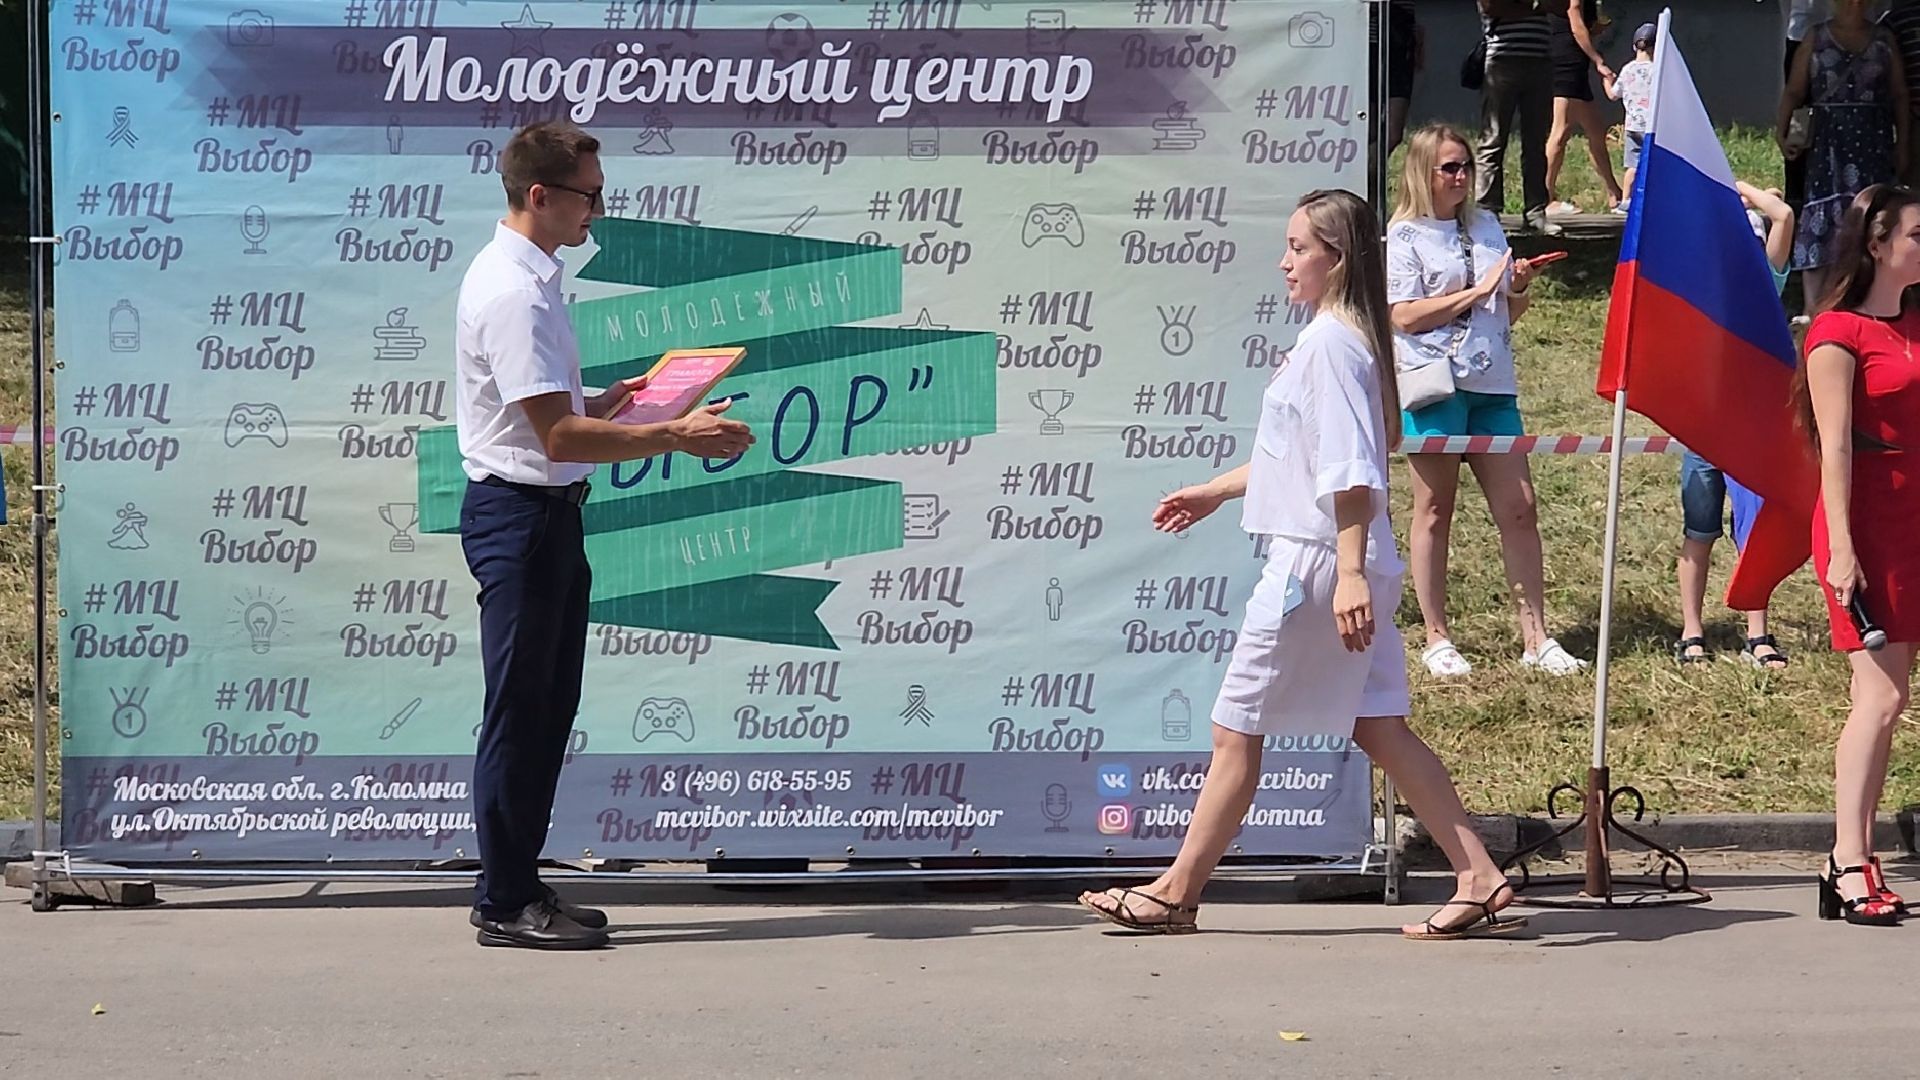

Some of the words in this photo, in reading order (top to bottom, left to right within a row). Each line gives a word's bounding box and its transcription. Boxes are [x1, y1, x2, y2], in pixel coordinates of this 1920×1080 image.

[61, 37, 181, 84] Выбор
[1121, 34, 1236, 78] Выбор
[383, 35, 860, 124] Молодёжный
[870, 50, 1094, 122] центр
[206, 92, 303, 135] #МЦ
[1255, 85, 1351, 127] #МЦ
[193, 137, 312, 182] Выбор
[730, 131, 848, 175] Выбор
[982, 130, 1099, 175] Выбор
[1242, 129, 1358, 173] Выбор
[77, 182, 175, 225] #МЦ
[348, 183, 444, 226] #МЦ
[867, 187, 963, 229] #МЦ
[1133, 187, 1229, 230] #МЦ
[64, 225, 183, 271] Выбор
[335, 228, 454, 273] Выбор
[1121, 230, 1236, 275] Выбор
[210, 291, 307, 334] #МЦ
[1000, 291, 1094, 333] #МЦ
[196, 335, 316, 381] Выбор
[995, 333, 1102, 378] Выбор
[73, 382, 171, 426] #МЦ
[350, 380, 448, 422] #МЦ
[1133, 381, 1228, 422] #МЦ
[60, 426, 180, 472] Выбор
[1121, 424, 1237, 470] Выбор
[1001, 462, 1096, 504] #МЦ
[212, 485, 309, 527] #МЦ
[679, 526, 751, 566] ЦЕНТР
[987, 506, 1103, 550] Выбор
[199, 529, 318, 573] Выбор
[84, 579, 181, 622] #МЦ
[352, 578, 450, 621] #МЦ
[869, 566, 965, 609] #МЦ
[1134, 576, 1230, 619] #МЦ
[70, 623, 189, 668] Выбор
[339, 622, 457, 667] Выбор
[857, 609, 973, 655] Выбор
[1121, 618, 1238, 664] Выбор
[215, 677, 312, 720] #МЦ
[746, 661, 843, 703] #МЦ
[1001, 673, 1096, 715] #МЦ
[201, 721, 319, 766] Выбор
[733, 704, 850, 750] Выбор
[988, 716, 1105, 762] Выбор
[113, 775, 267, 802] Московская
[271, 776, 324, 801] обл.
[661, 771, 677, 793] 8
[684, 769, 741, 797] (496)
[747, 769, 853, 793] 618-55-95
[871, 763, 967, 803] #МЦ
[331, 805, 477, 838] революции,
[654, 803, 1003, 835] mcvibor.wixsite.com/mcvibor
